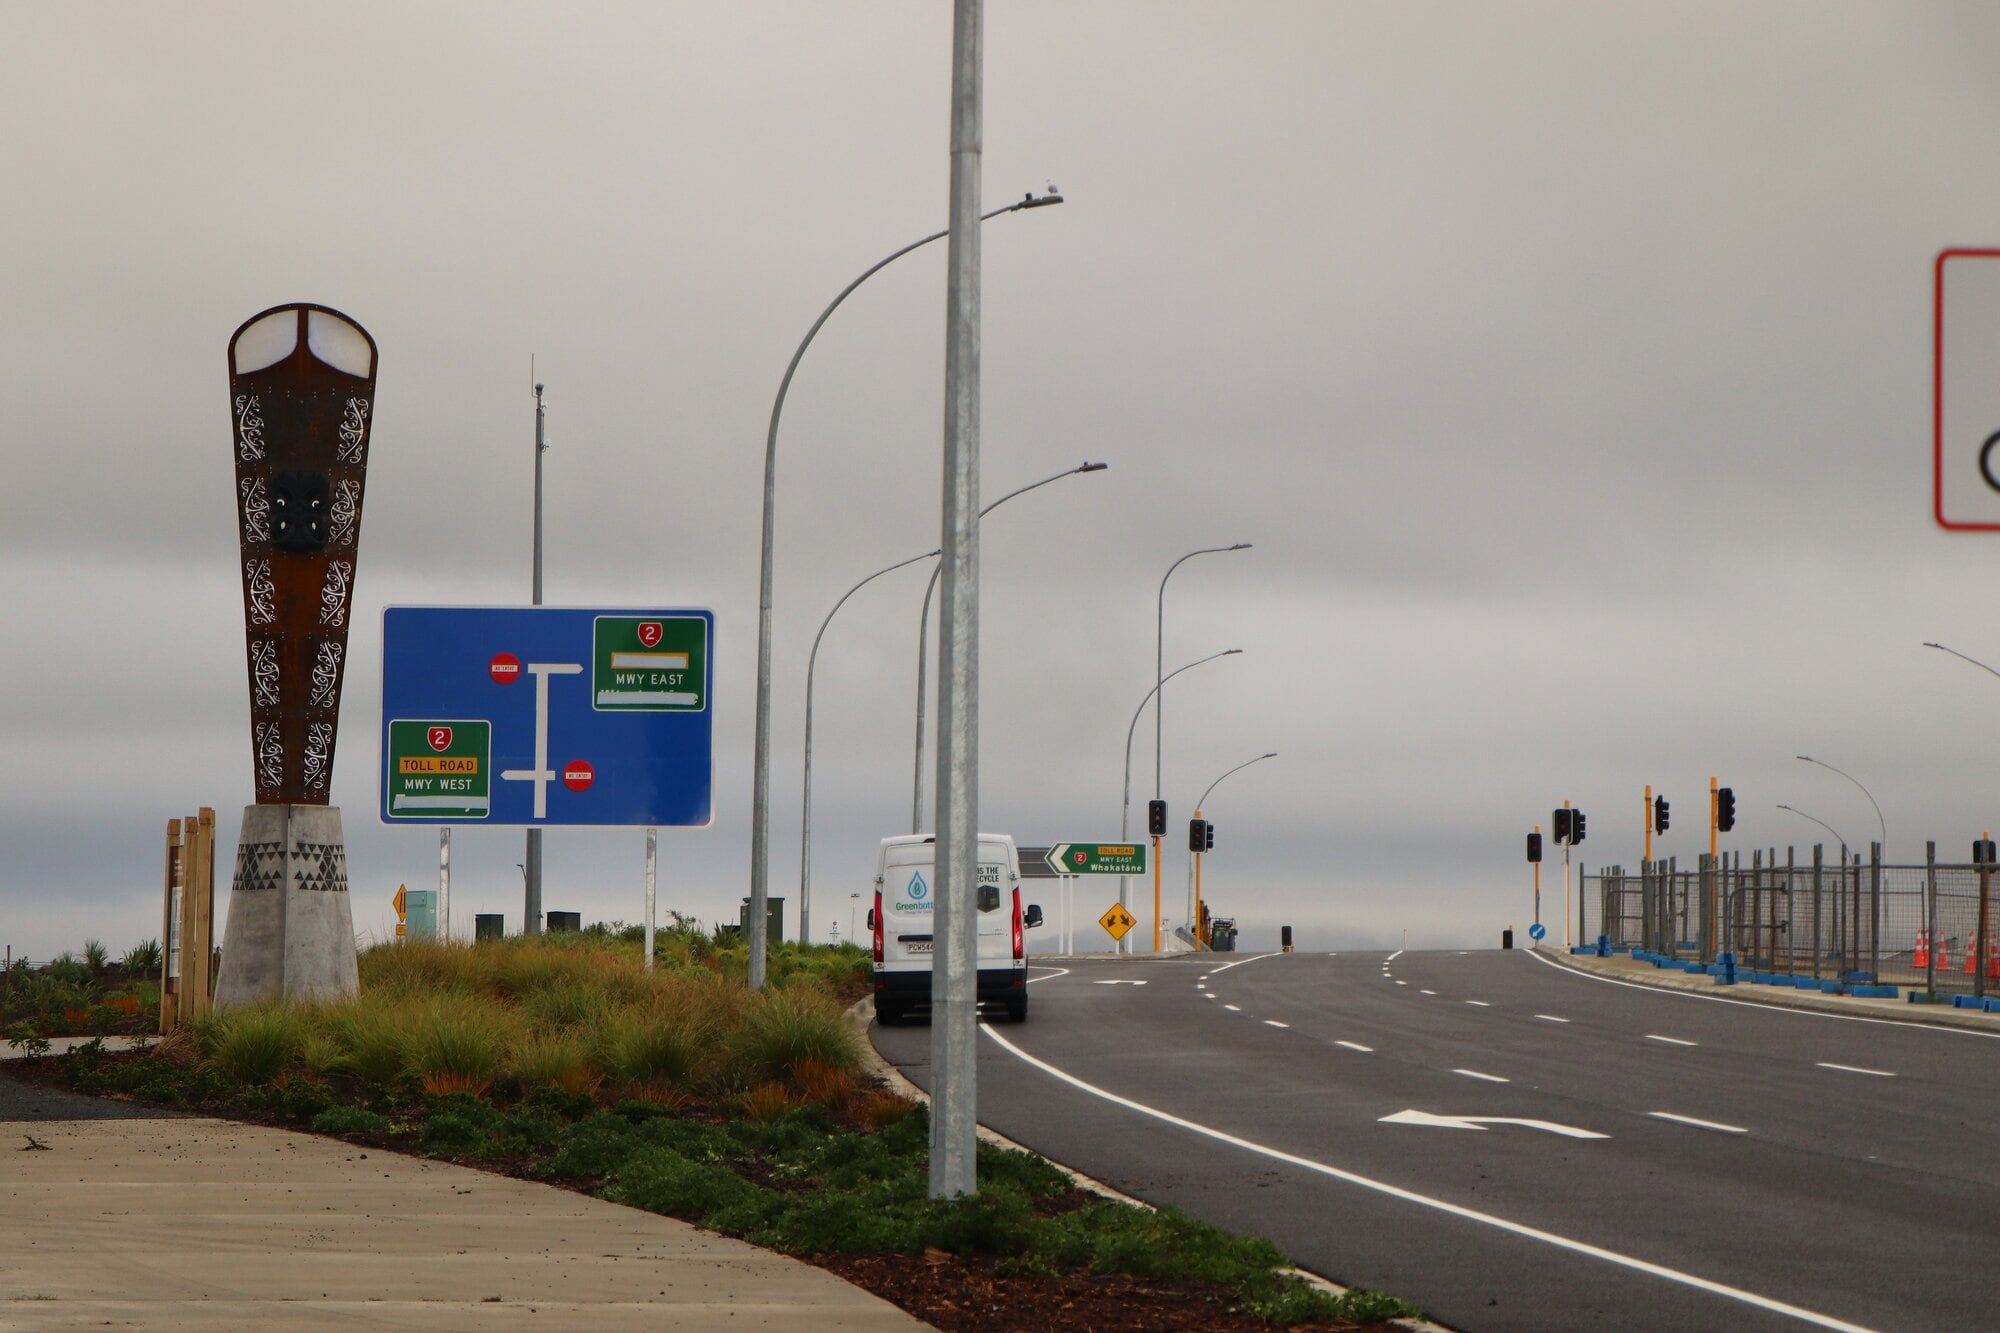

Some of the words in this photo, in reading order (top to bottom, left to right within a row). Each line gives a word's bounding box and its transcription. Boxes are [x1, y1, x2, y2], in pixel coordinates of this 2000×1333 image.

[645, 626, 655, 640] 2
[616, 674, 645, 685] MWY
[651, 674, 684, 685] EAST
[434, 730, 445, 745] 2
[403, 760, 434, 771] TOLL
[440, 760, 474, 771] ROAD
[405, 779, 433, 790] MWY
[440, 779, 472, 790] WEST
[1077, 854, 1083, 862] 2
